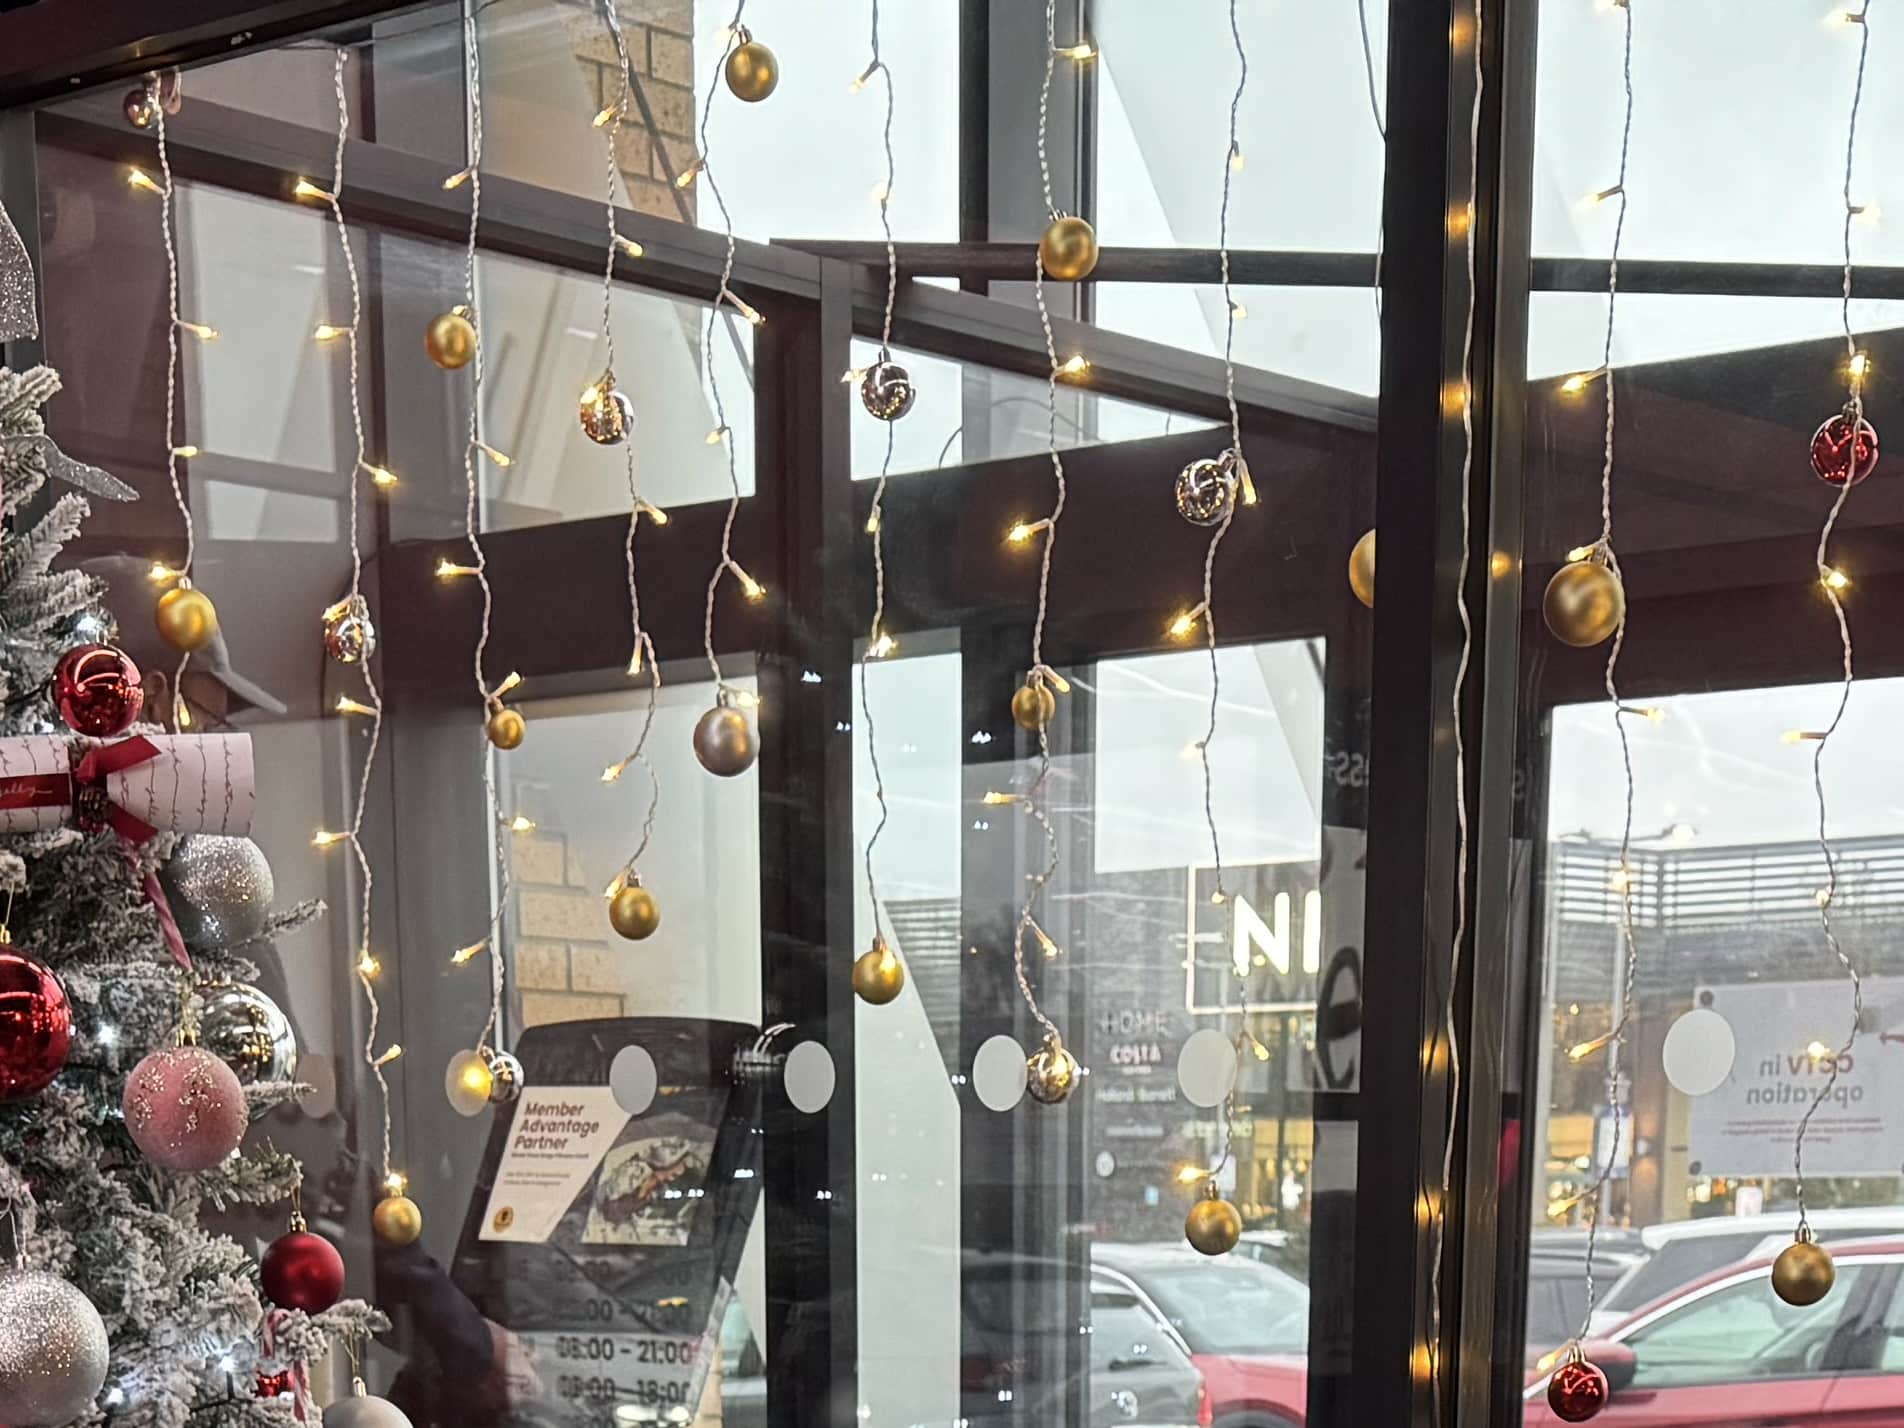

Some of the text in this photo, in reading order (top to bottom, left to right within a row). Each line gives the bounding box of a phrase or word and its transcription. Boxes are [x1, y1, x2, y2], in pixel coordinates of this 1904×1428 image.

[524, 1101, 584, 1117] Member
[519, 1119, 600, 1138] Advantage
[514, 1135, 568, 1150] Partner
